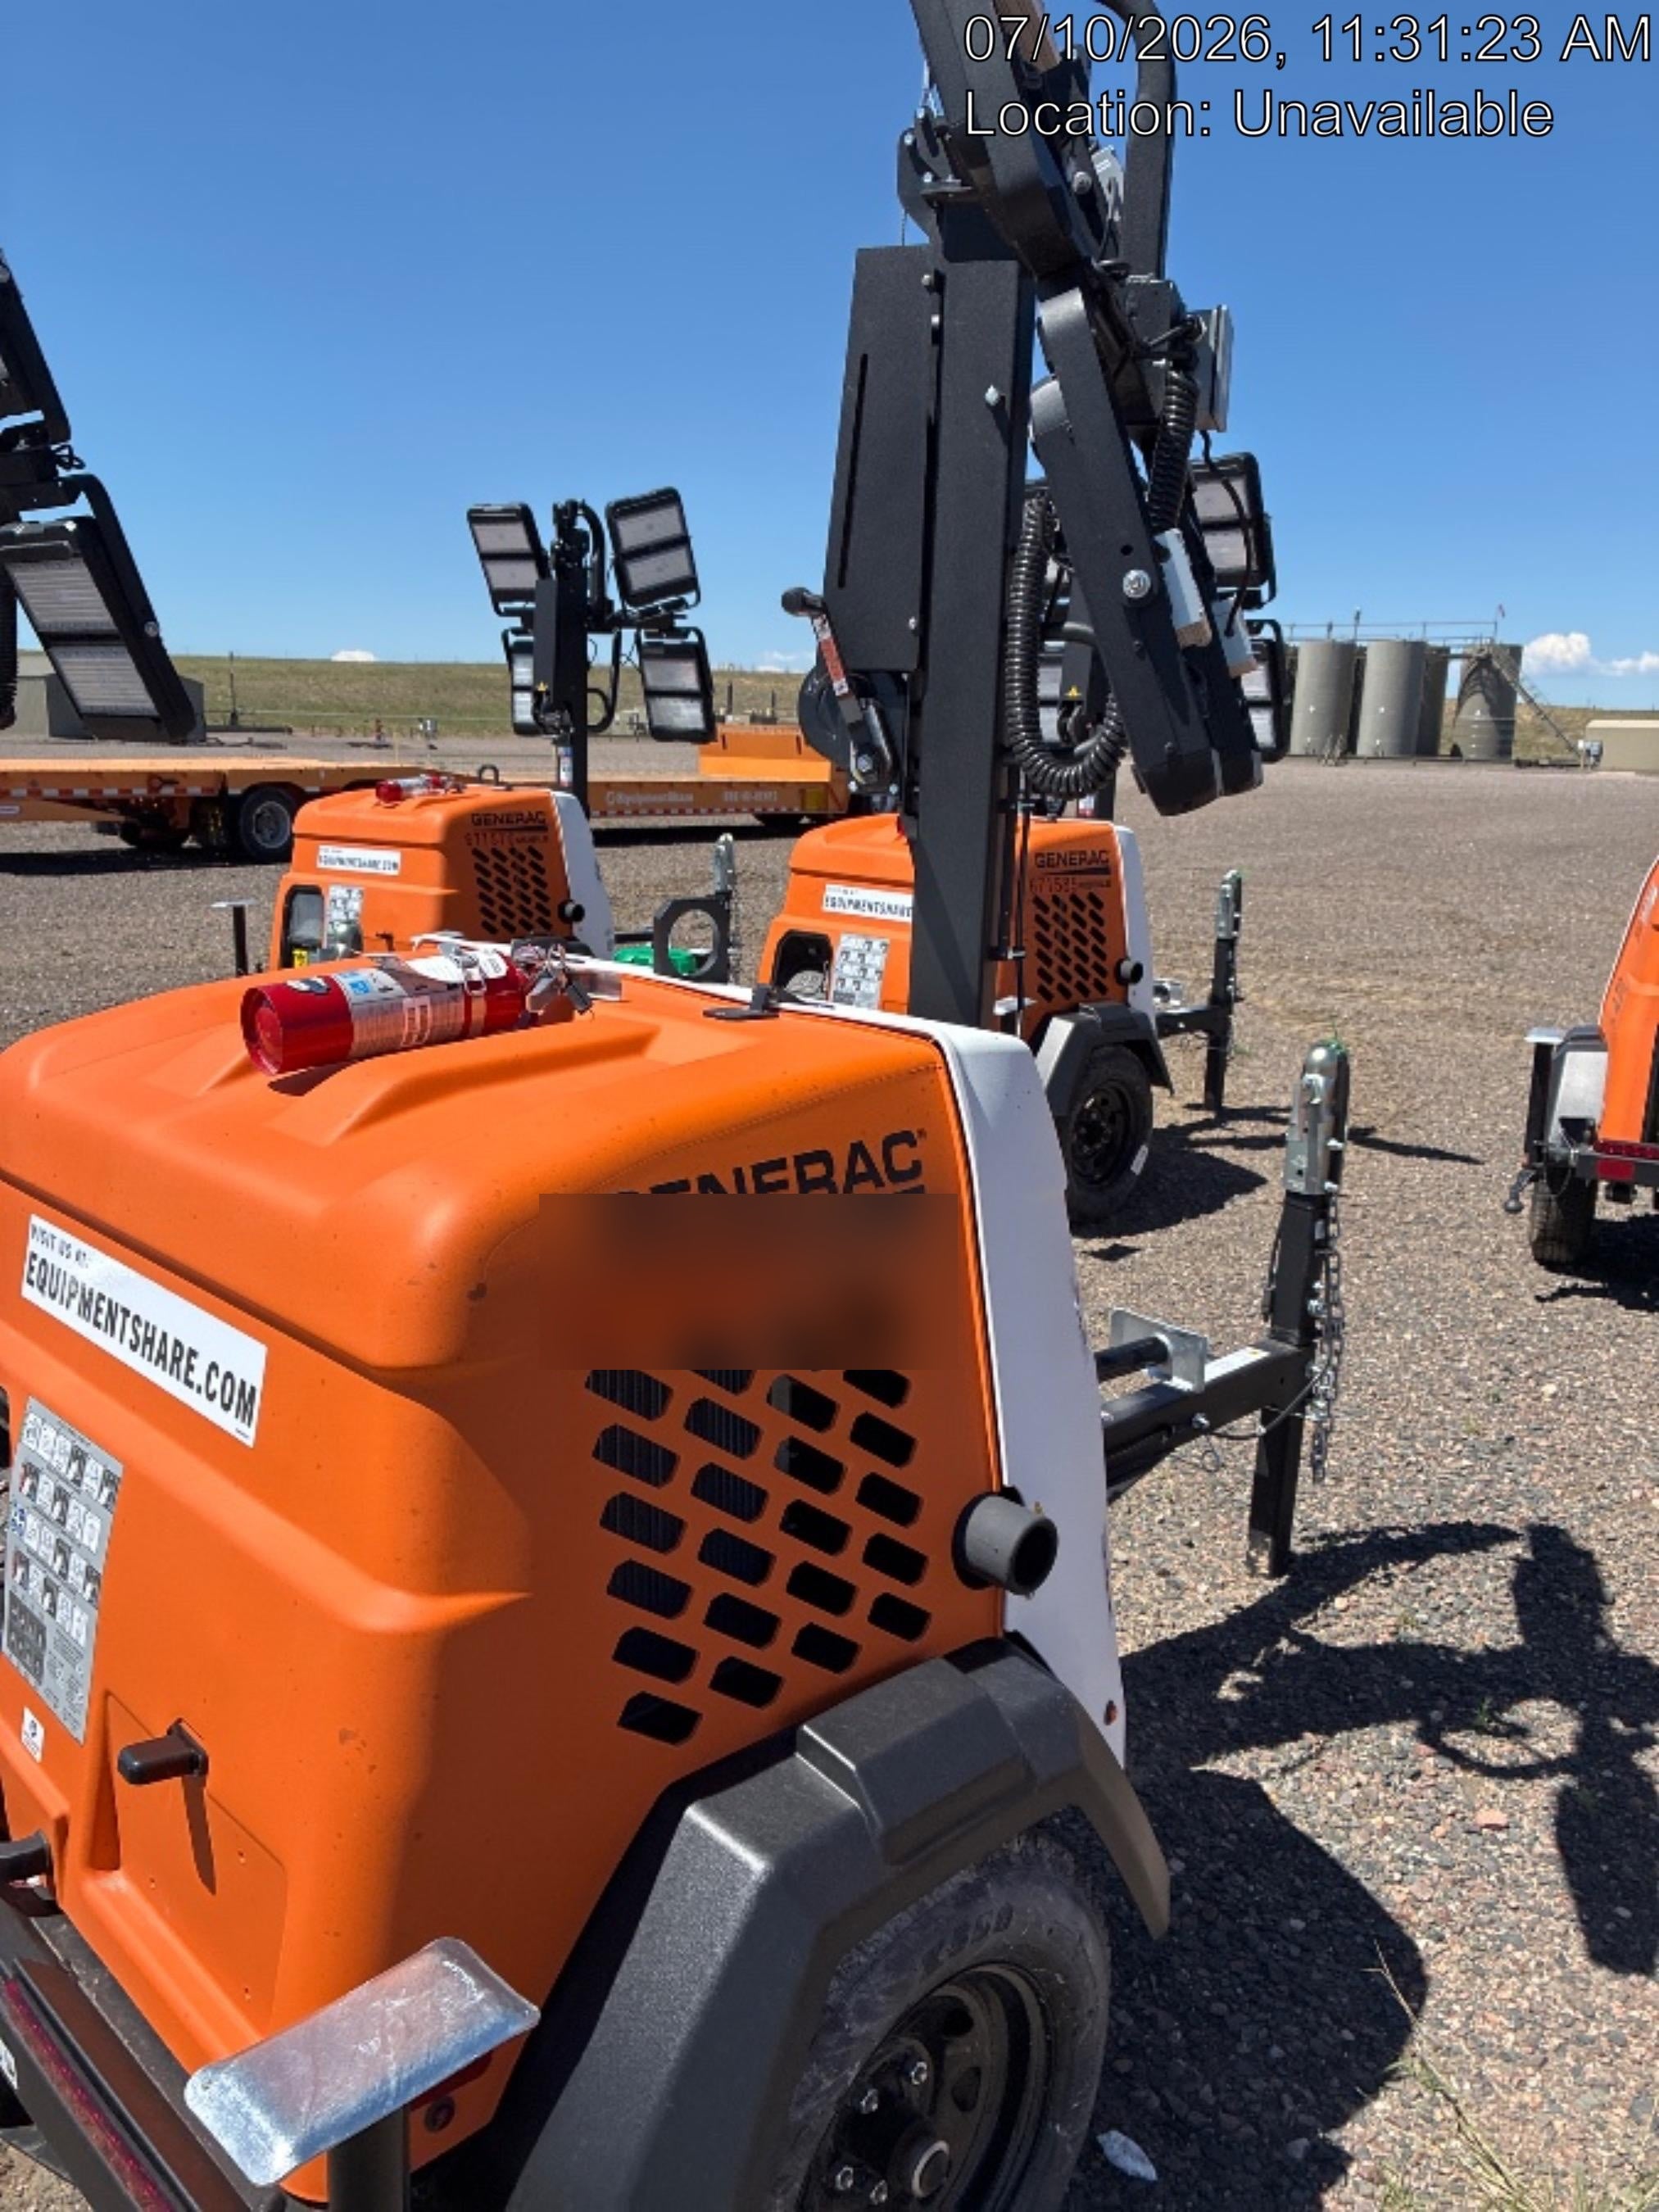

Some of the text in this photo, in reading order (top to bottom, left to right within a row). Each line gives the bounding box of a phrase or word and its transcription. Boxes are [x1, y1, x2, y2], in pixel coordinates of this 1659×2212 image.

[472, 811, 546, 827] GENERAC
[1035, 850, 1109, 868] GENERAC
[617, 1130, 923, 1194] ERAC
[25, 1249, 257, 1429] EQUIPMENTSHARE.COM
